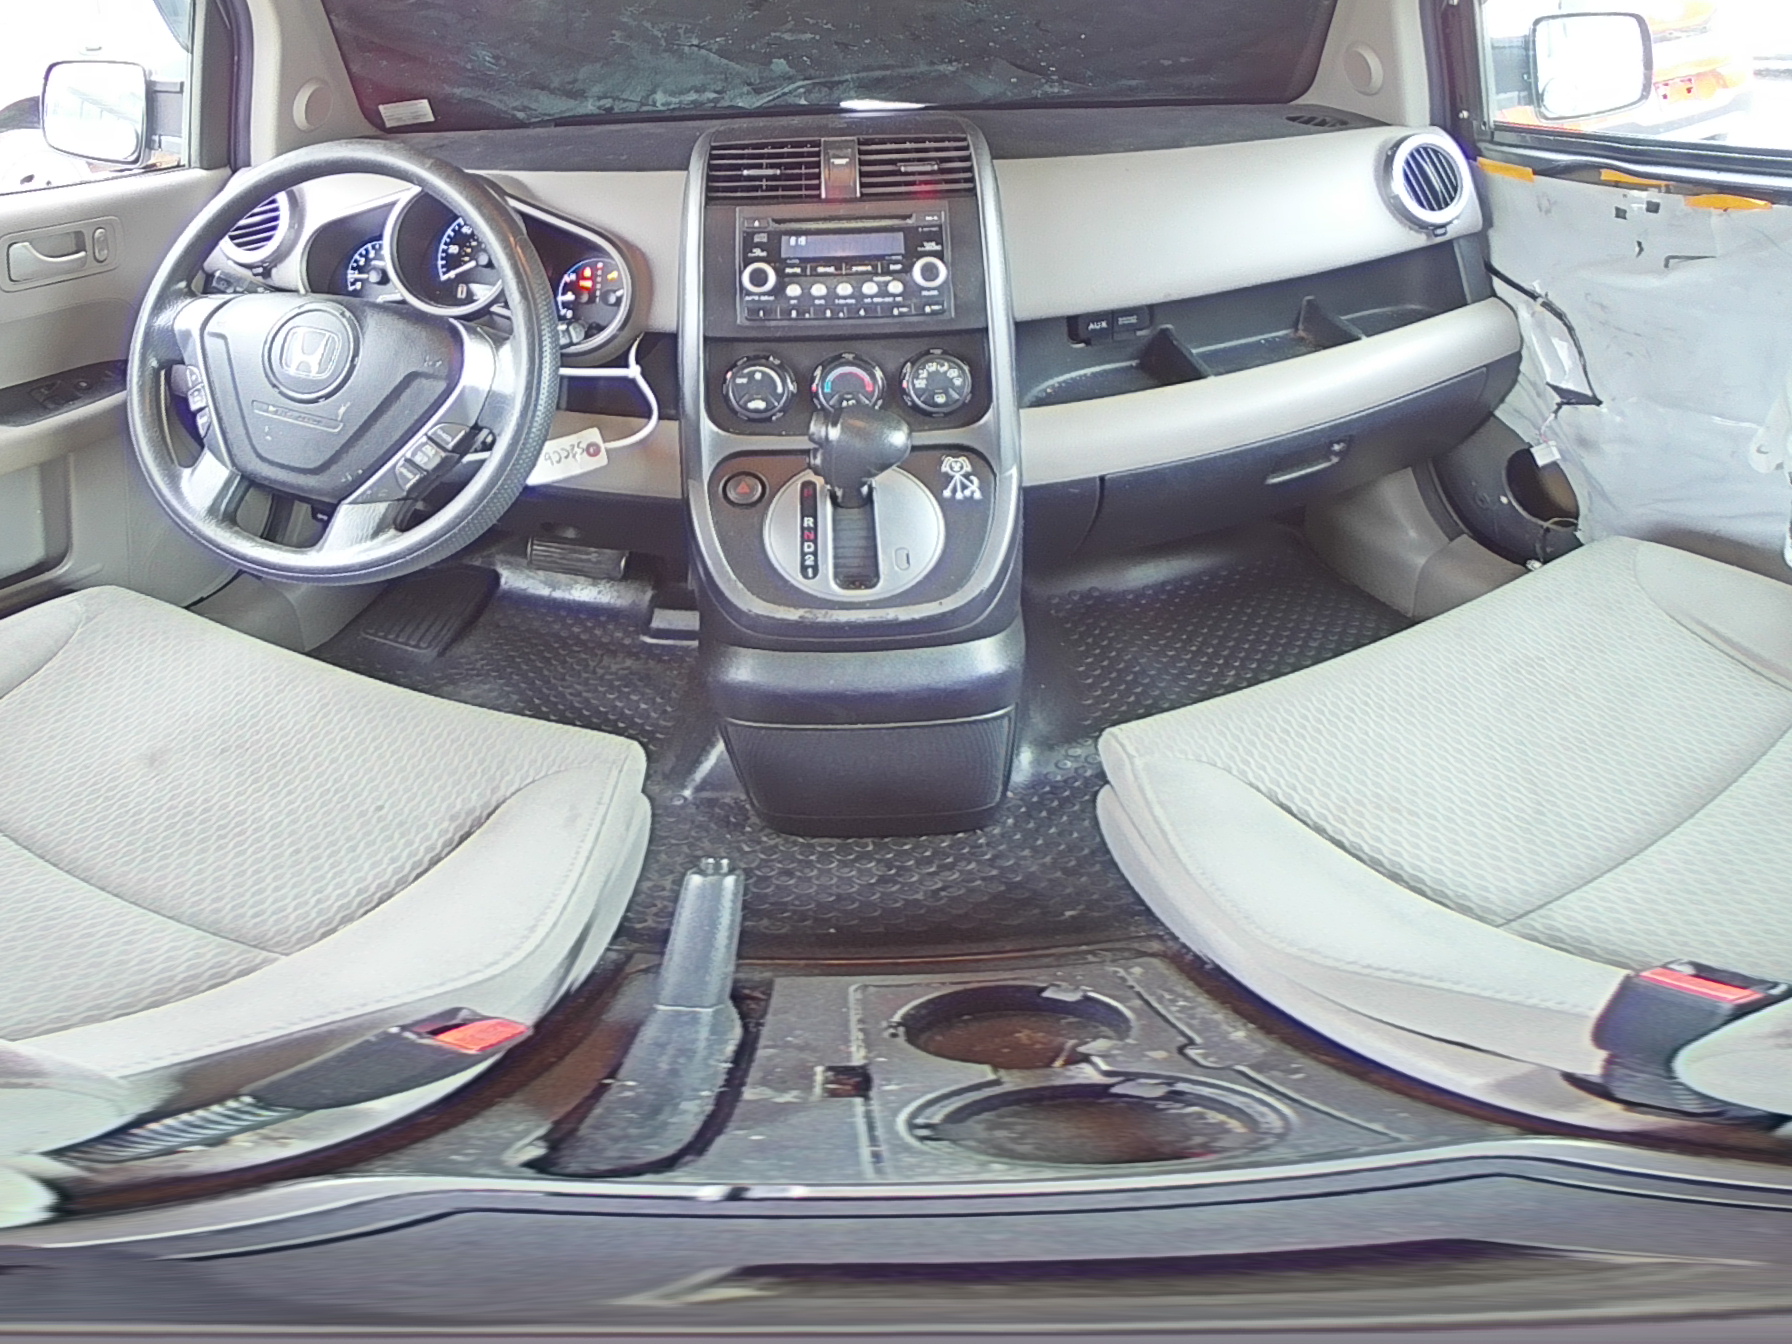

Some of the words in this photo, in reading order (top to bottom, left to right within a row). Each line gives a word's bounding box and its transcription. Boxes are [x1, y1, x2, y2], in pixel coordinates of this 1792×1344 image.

[1088, 320, 1108, 331] AUX
[803, 517, 814, 527] R
[803, 531, 815, 540] N
[803, 542, 814, 553] D
[804, 555, 814, 565] 2
[807, 567, 813, 578] 1
